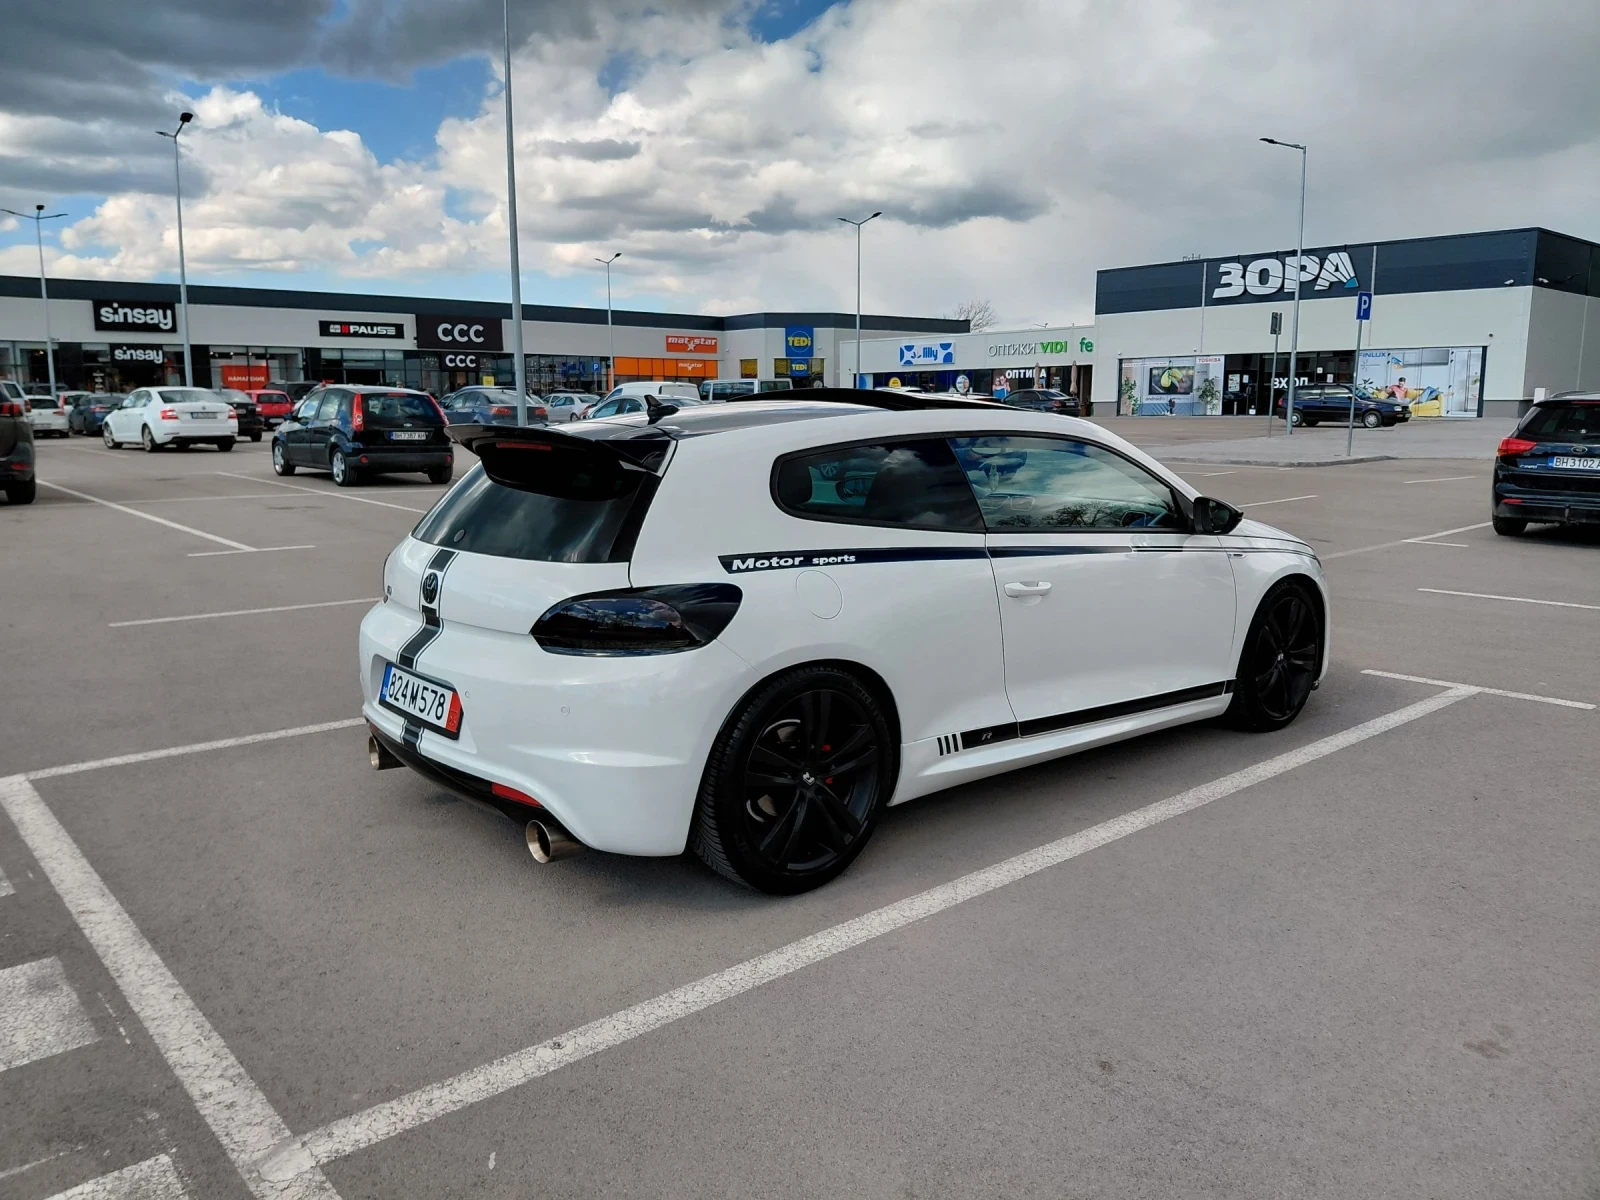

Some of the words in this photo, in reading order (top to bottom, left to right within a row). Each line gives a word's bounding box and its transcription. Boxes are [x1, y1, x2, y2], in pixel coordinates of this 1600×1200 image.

[1212, 251, 1359, 299] ЗОРА
[1361, 296, 1368, 316] P
[100, 302, 172, 329] sinsay
[350, 325, 396, 335] PAUSE
[437, 323, 485, 343] CCC
[114, 346, 163, 364] sinsay
[923, 346, 938, 361] lilly
[988, 342, 1037, 358] ОПТИКИ
[1040, 341, 1068, 354] VIDI
[445, 354, 476, 368] CCC
[732, 556, 804, 571] Motor
[812, 554, 856, 566] sports
